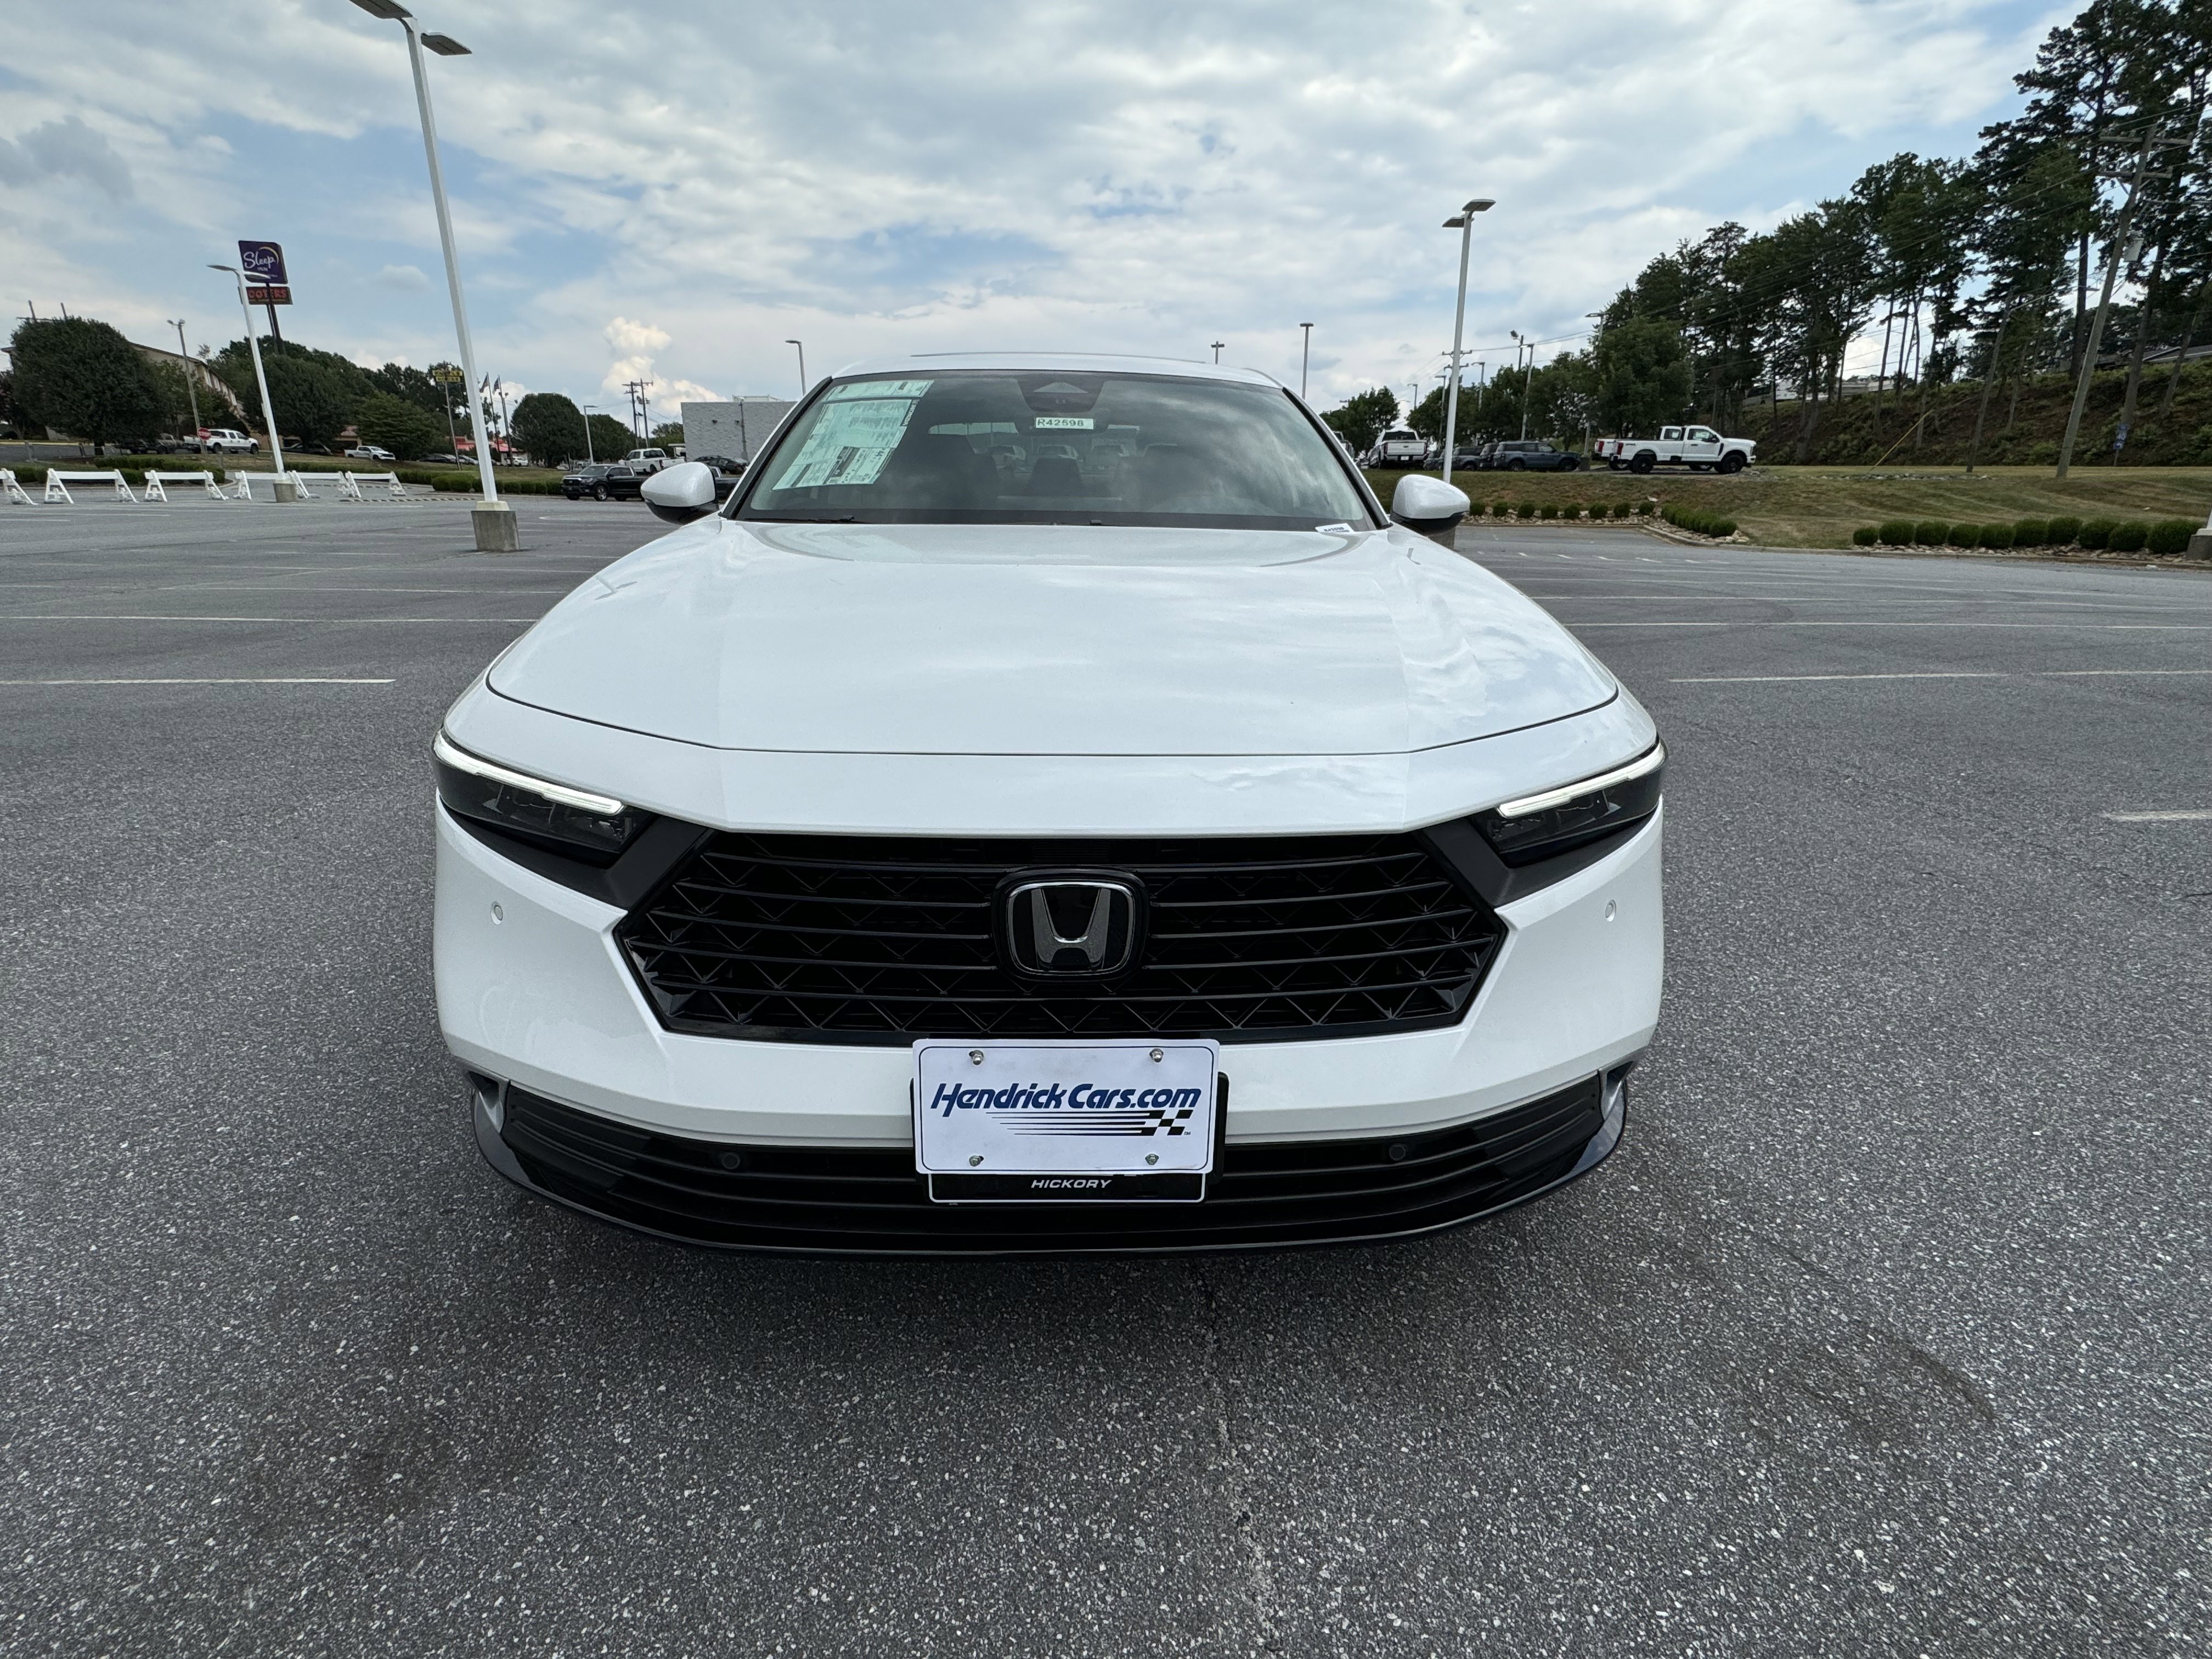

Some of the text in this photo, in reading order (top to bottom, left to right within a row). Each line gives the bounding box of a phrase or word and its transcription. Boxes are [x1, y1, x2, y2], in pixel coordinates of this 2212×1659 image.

[243, 251, 275, 269] Sleep
[930, 1082, 1202, 1118] HendrickCars.com
[1031, 1179, 1113, 1188] HICKORY
